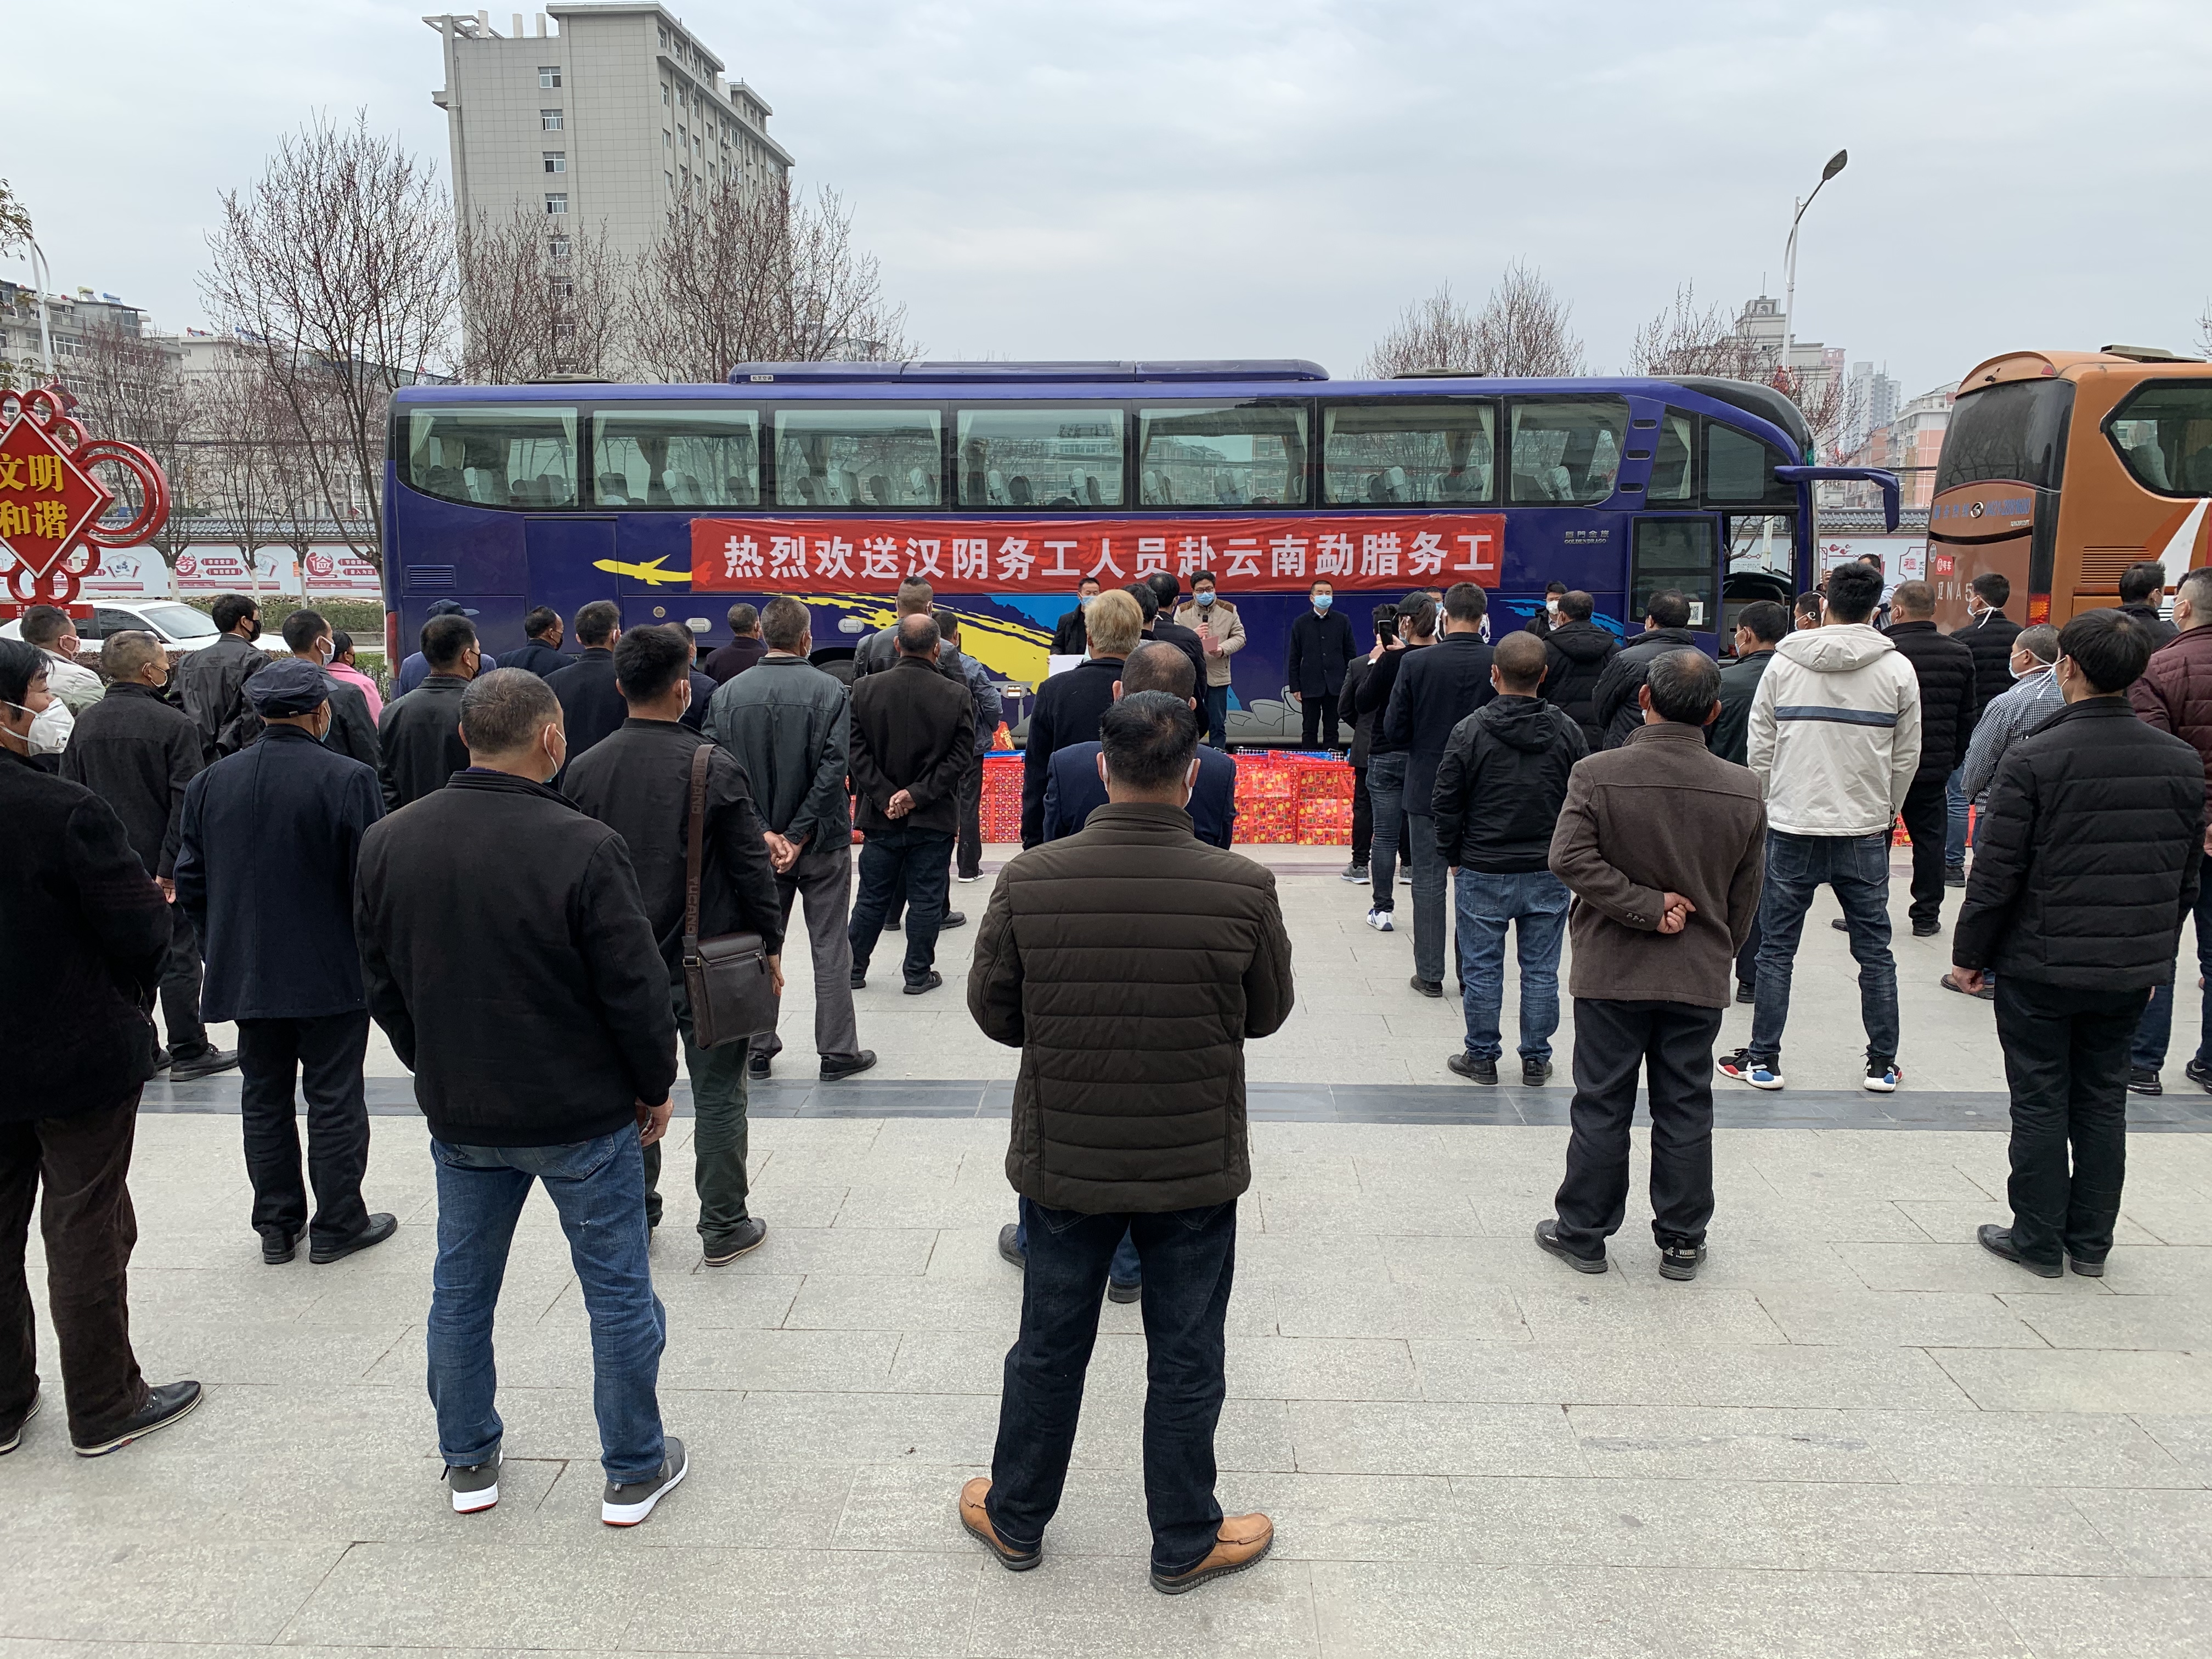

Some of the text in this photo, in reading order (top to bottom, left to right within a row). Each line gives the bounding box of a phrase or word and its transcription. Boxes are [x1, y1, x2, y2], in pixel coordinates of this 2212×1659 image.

[0, 453, 64, 492] 文明
[0, 500, 67, 539] 和谐
[724, 531, 1494, 580] 热烈欢送汉阴务工人员赴云南勐腊务工
